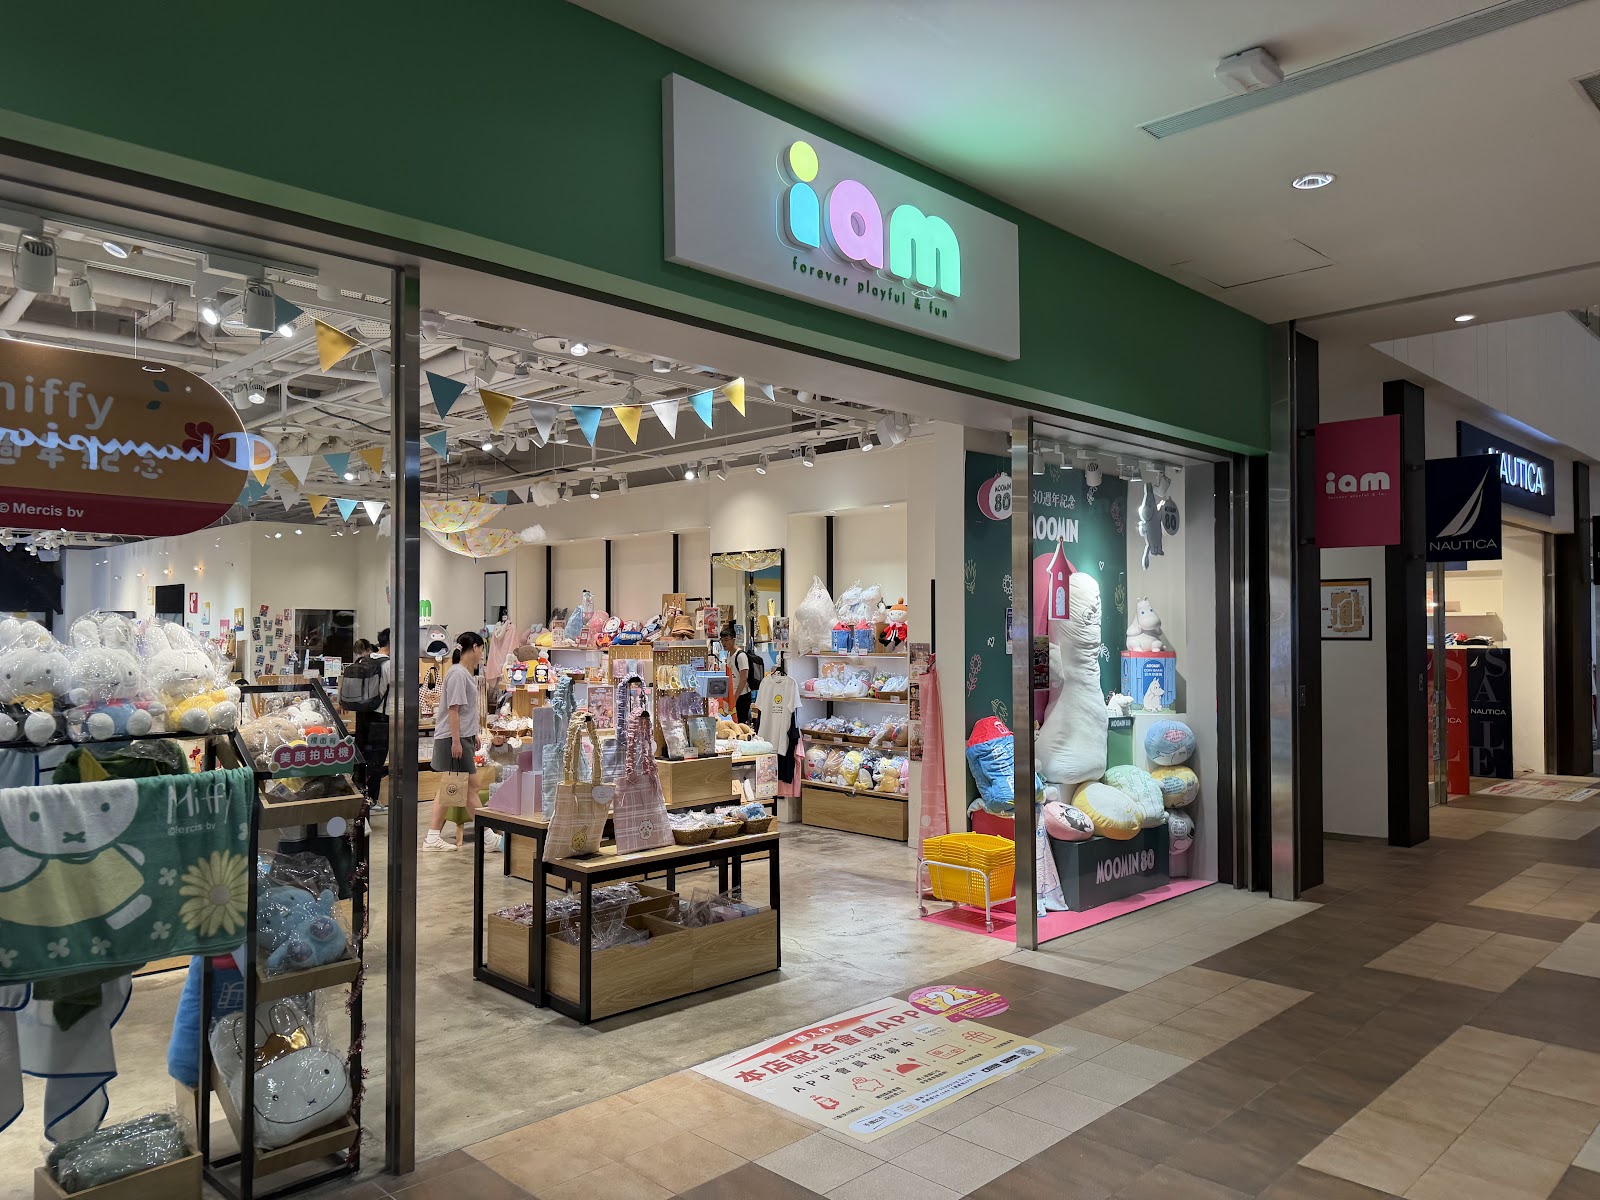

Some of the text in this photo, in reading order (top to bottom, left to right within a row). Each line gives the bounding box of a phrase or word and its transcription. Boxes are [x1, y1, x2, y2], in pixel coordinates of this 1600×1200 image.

[784, 140, 961, 298] iam
[792, 256, 949, 319] forever playful & fun
[1325, 471, 1391, 495] iam
[1488, 447, 1546, 496] AUTICA
[12, 502, 64, 518] Mercis
[66, 506, 85, 518] bv
[994, 492, 1011, 512] 80
[1033, 513, 1079, 543] OOMIN
[1165, 513, 1177, 531] 80
[1429, 538, 1498, 552] NAUTICA
[1470, 707, 1507, 716] NAUTICA
[279, 746, 350, 764] 美顏拍貼機
[166, 782, 233, 825] Miffy
[1096, 848, 1155, 885] MOOMIN 80
[793, 1035, 900, 1080] Mitsui Shopping Park
